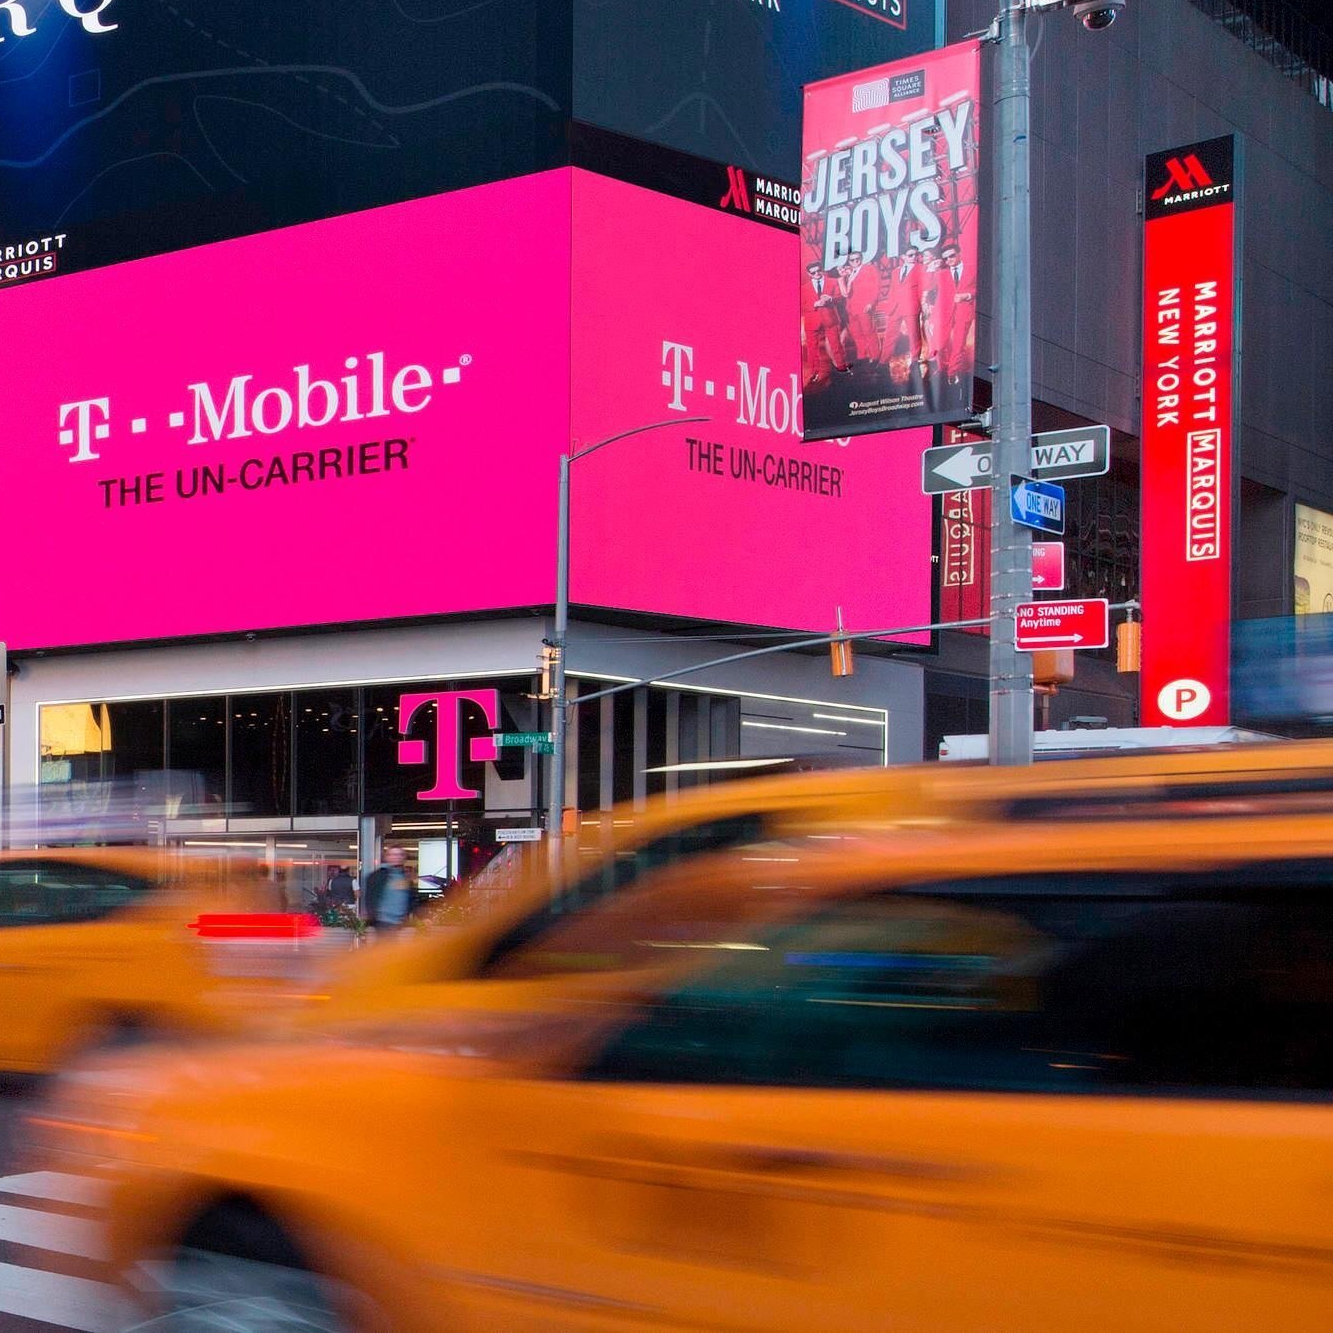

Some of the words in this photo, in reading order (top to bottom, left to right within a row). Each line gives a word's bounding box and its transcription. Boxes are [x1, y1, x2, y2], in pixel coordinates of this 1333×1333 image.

[892, 81, 921, 94] SQUARE
[894, 75, 919, 86] TIMES
[805, 100, 972, 215] JERSEY
[1164, 183, 1230, 206] MARRIOTT
[823, 180, 942, 270] BOYS
[1158, 288, 1180, 347] NEW
[1193, 281, 1219, 421] MARRIOTT
[1158, 364, 1180, 428] YORK
[98, 472, 164, 509] THE
[177, 440, 409, 500] UN-CARRIER
[686, 438, 724, 476] THE
[730, 446, 844, 498] UN-CARRIER
[1036, 442, 1086, 466] WAY
[1026, 491, 1042, 514] ONE
[1043, 497, 1059, 516] WAY
[1192, 434, 1216, 556] MARQUIS
[1020, 606, 1034, 618] NO
[1037, 604, 1084, 617] STANDING
[1020, 617, 1061, 629] Anytime
[1176, 688, 1196, 712] P
[398, 689, 502, 801] T
[505, 735, 548, 745] Broadway
